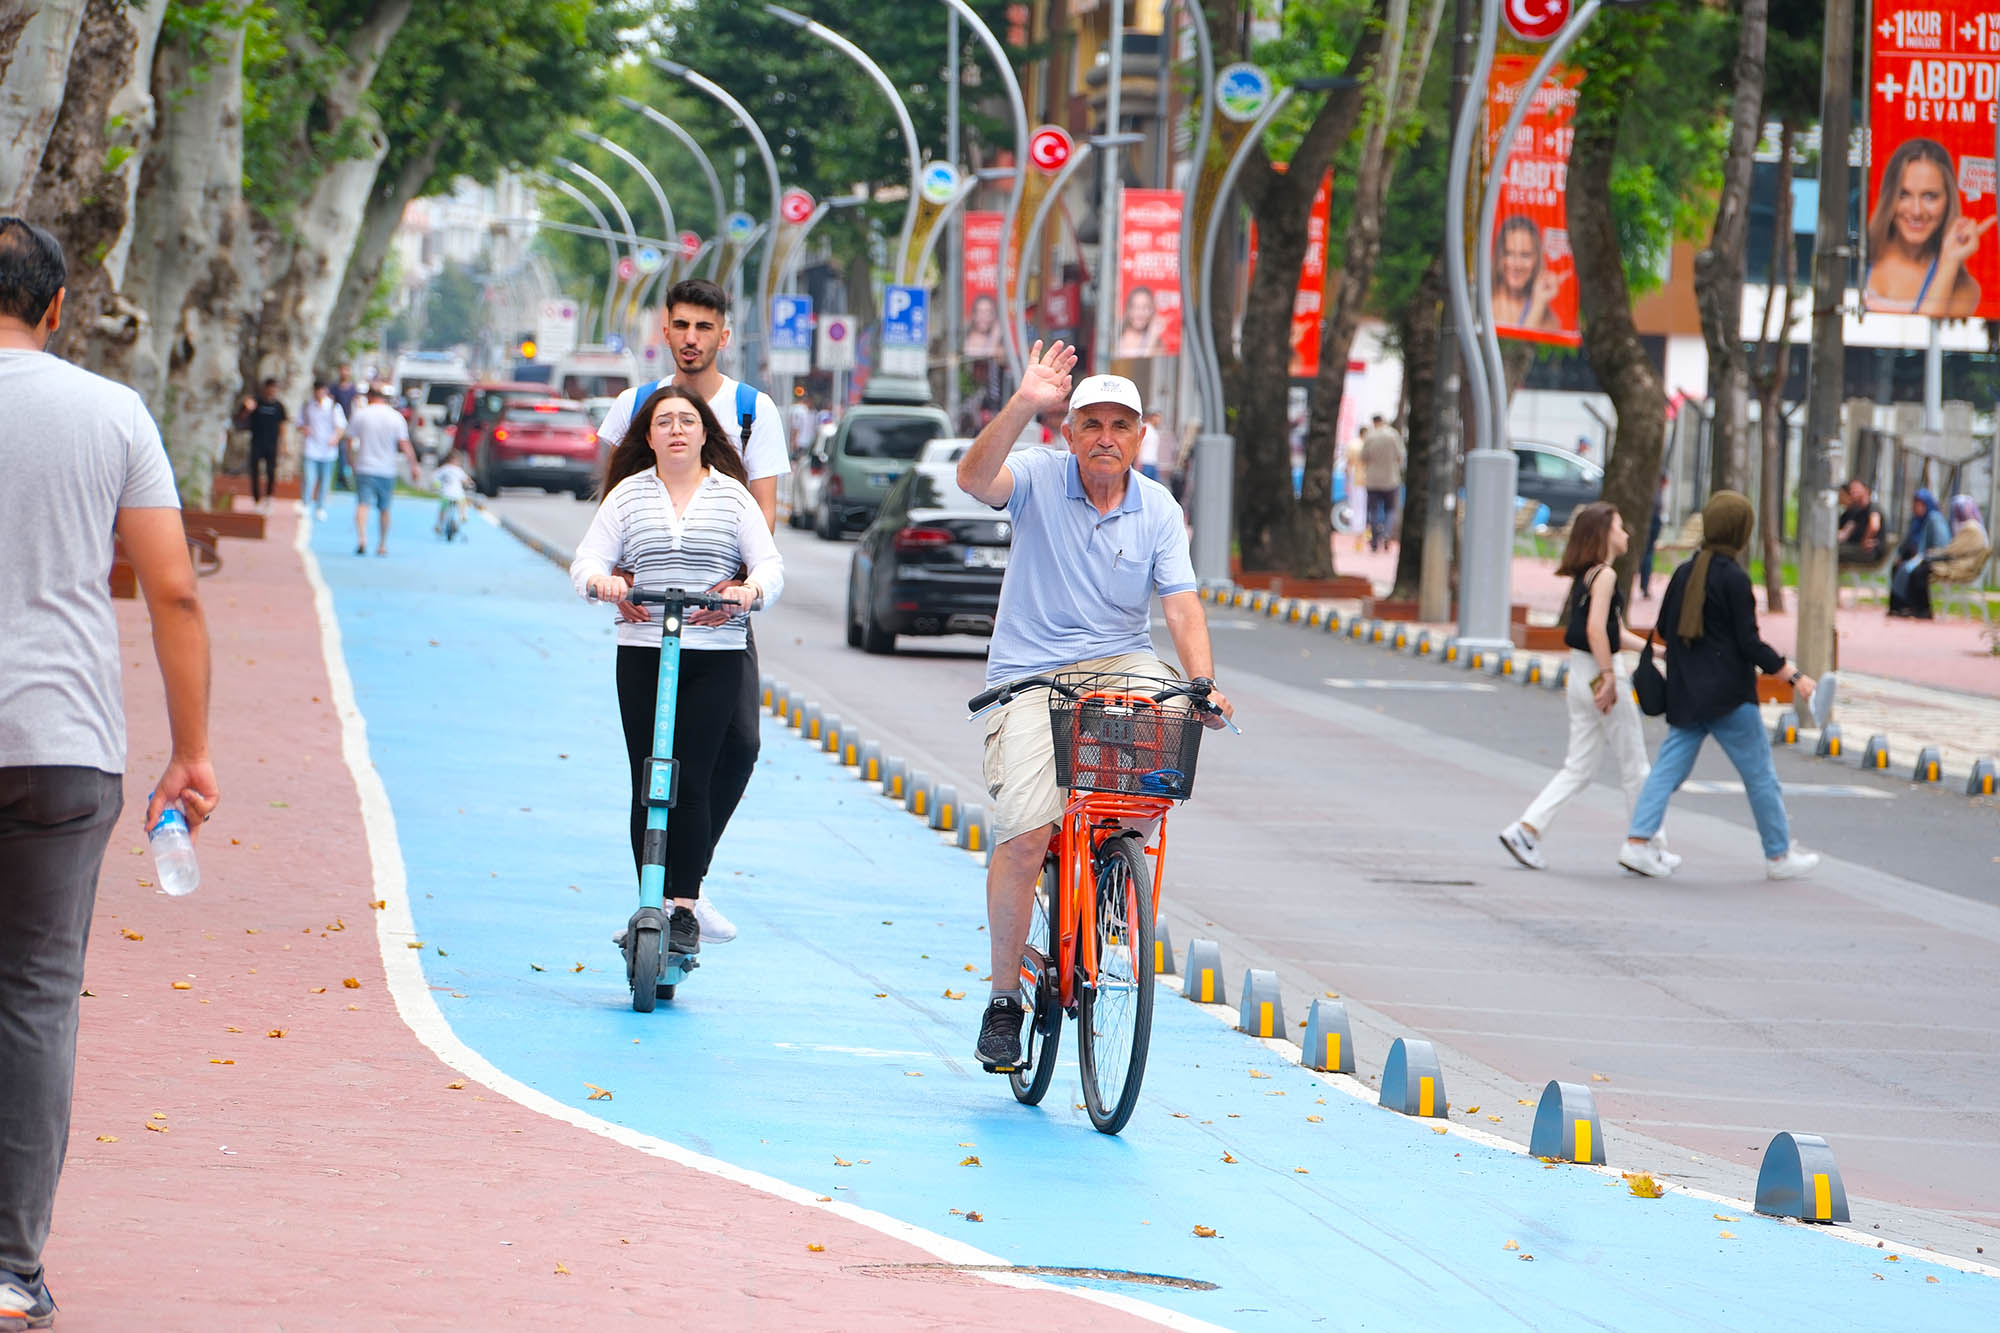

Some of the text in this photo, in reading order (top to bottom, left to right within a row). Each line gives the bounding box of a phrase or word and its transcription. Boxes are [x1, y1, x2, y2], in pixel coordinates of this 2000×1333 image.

[1905, 10, 1942, 36] KUR
[1906, 60, 2000, 101] ABD'D
[1905, 100, 1976, 122] DEVAM
[775, 301, 796, 326] P
[888, 290, 911, 319] P
